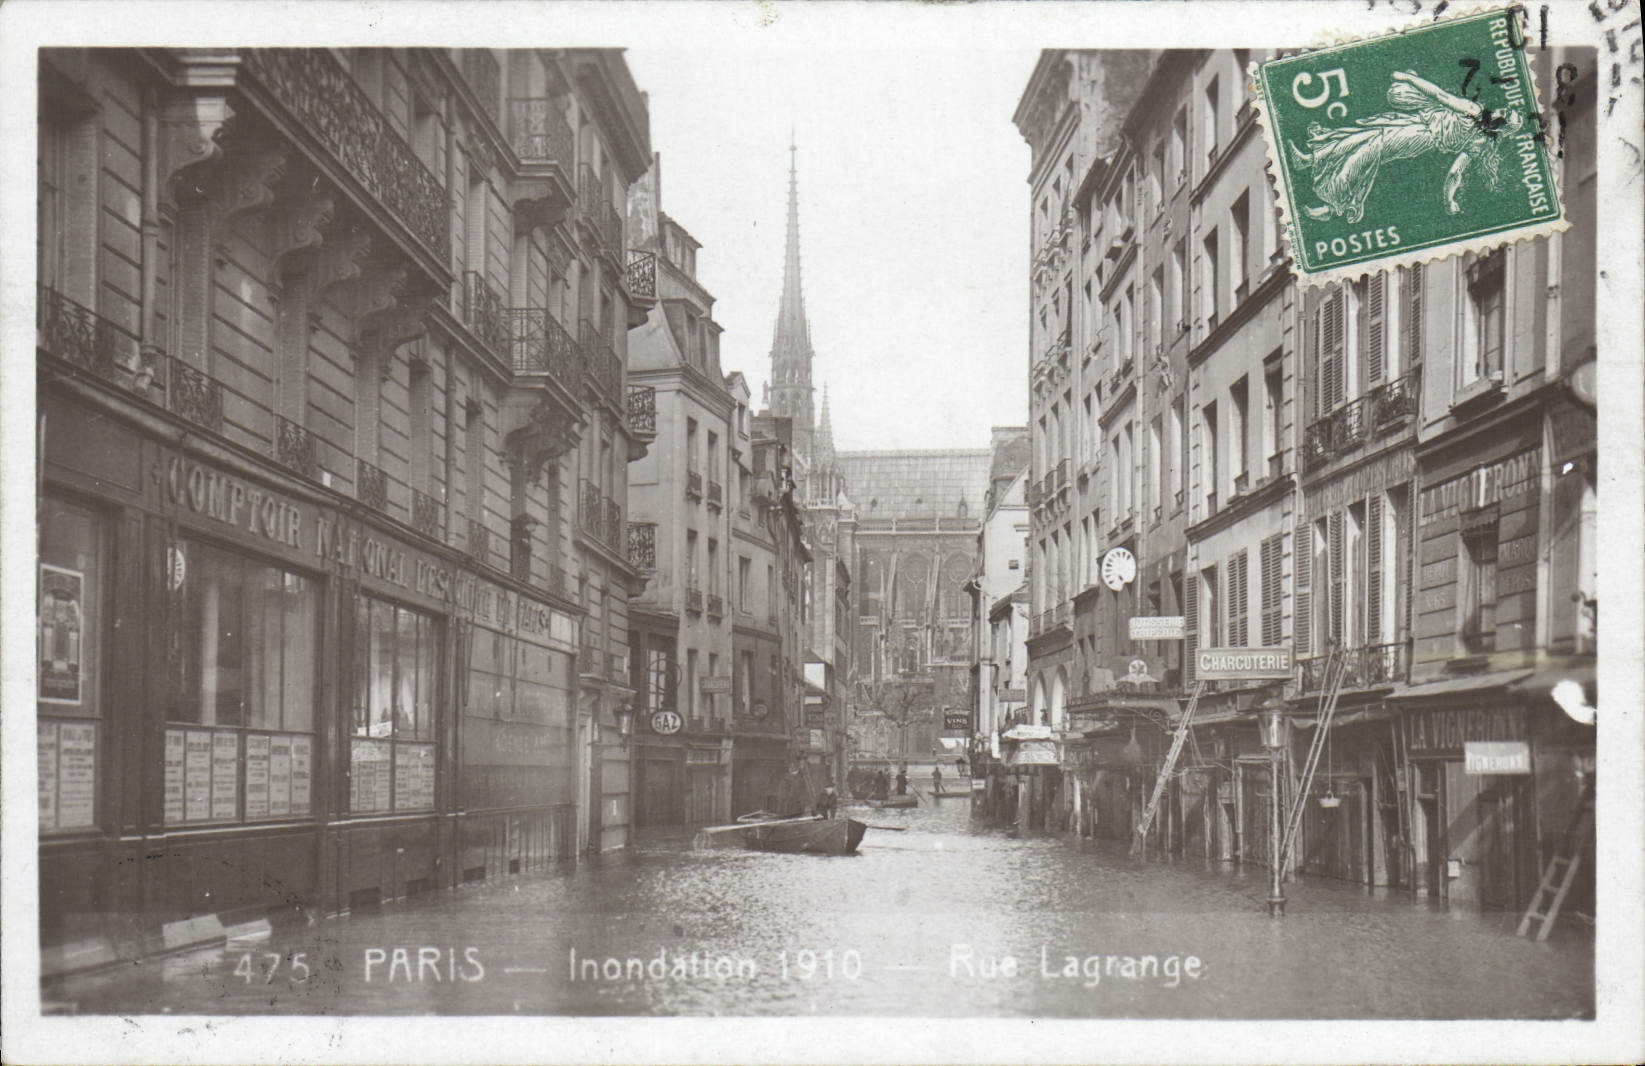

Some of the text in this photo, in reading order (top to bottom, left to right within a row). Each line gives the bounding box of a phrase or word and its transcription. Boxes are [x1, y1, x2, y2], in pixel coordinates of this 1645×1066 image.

[1293, 67, 1349, 108] 5
[1515, 132, 1550, 216] FRANÇAISE
[1315, 225, 1401, 261] POSTES
[169, 457, 301, 549] COMPTOIR
[314, 517, 408, 589] NATIONAL
[1200, 654, 1289, 671] CHARCUTERIE
[654, 714, 678, 732] GAZ
[1410, 713, 1427, 750] LA
